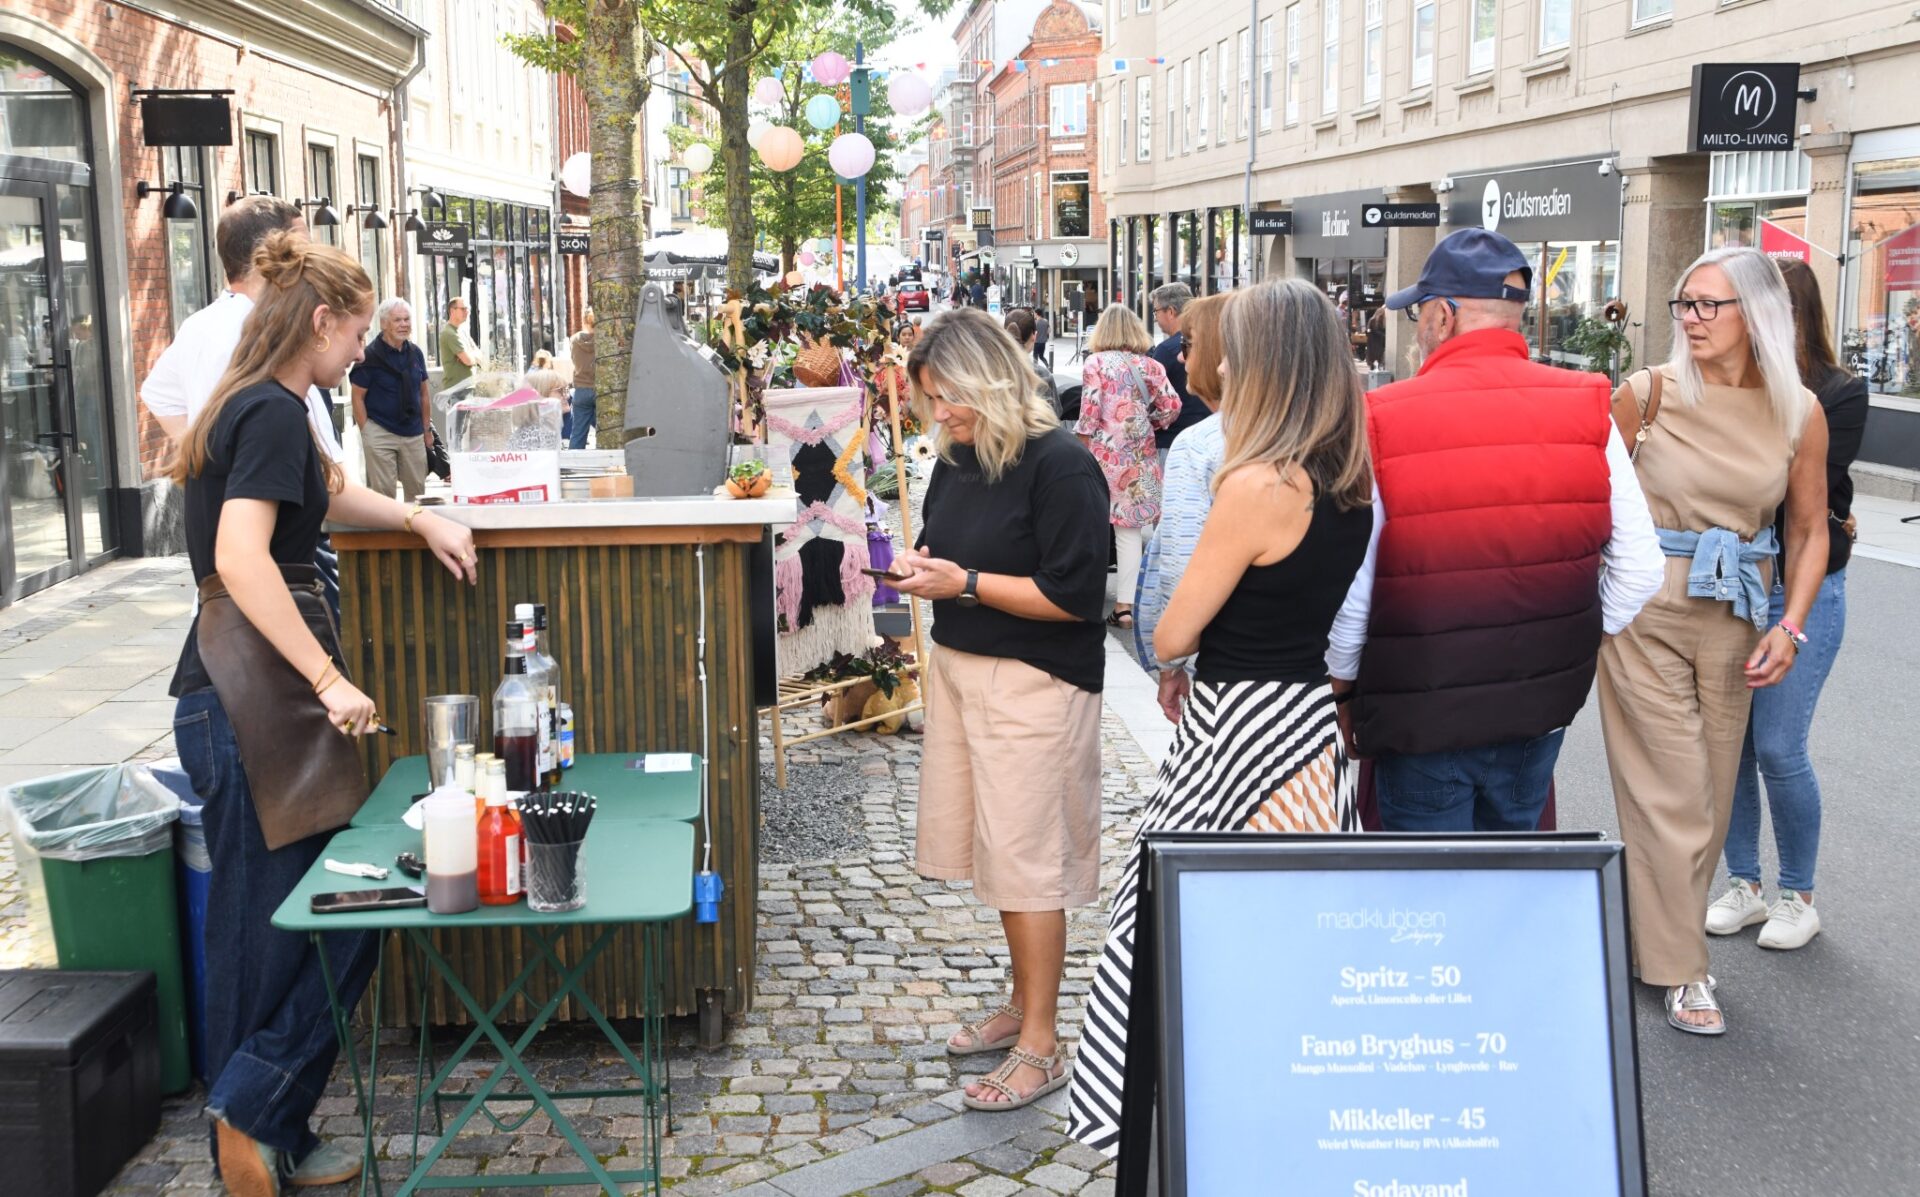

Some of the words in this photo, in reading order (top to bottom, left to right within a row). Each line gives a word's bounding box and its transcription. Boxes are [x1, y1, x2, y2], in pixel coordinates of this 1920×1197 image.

[1734, 84, 1761, 116] M
[1703, 133, 1788, 145] MILTO-LIVING
[1503, 187, 1571, 219] Guldsmedien
[1254, 219, 1265, 228] lift
[1265, 218, 1287, 228] clinic
[1383, 210, 1437, 220] Guldsmedien
[1316, 907, 1446, 929] madklubben
[1340, 965, 1409, 992] Spritz
[1431, 965, 1461, 988] 50
[1368, 992, 1422, 1005] Limoncello
[1424, 992, 1446, 1004] eller
[1448, 992, 1473, 1004] Lillet
[1300, 1034, 1357, 1057] Fanø
[1361, 1033, 1454, 1060] Bryghus
[1476, 1032, 1507, 1054] 70
[1290, 1061, 1326, 1076] Mango
[1327, 1061, 1375, 1073] Mussolini
[1382, 1061, 1427, 1073] Vadehav
[1436, 1060, 1490, 1074] Lynghvede
[1329, 1107, 1434, 1132] Mikkeller
[1457, 1107, 1486, 1130] 45
[1317, 1138, 1348, 1150] Weird
[1349, 1138, 1393, 1150] Weather
[1395, 1138, 1420, 1151] Hazy
[1423, 1137, 1441, 1148] IPA
[1442, 1136, 1500, 1149] (Alkoholfri)
[1353, 1177, 1468, 1197] Sodavand
